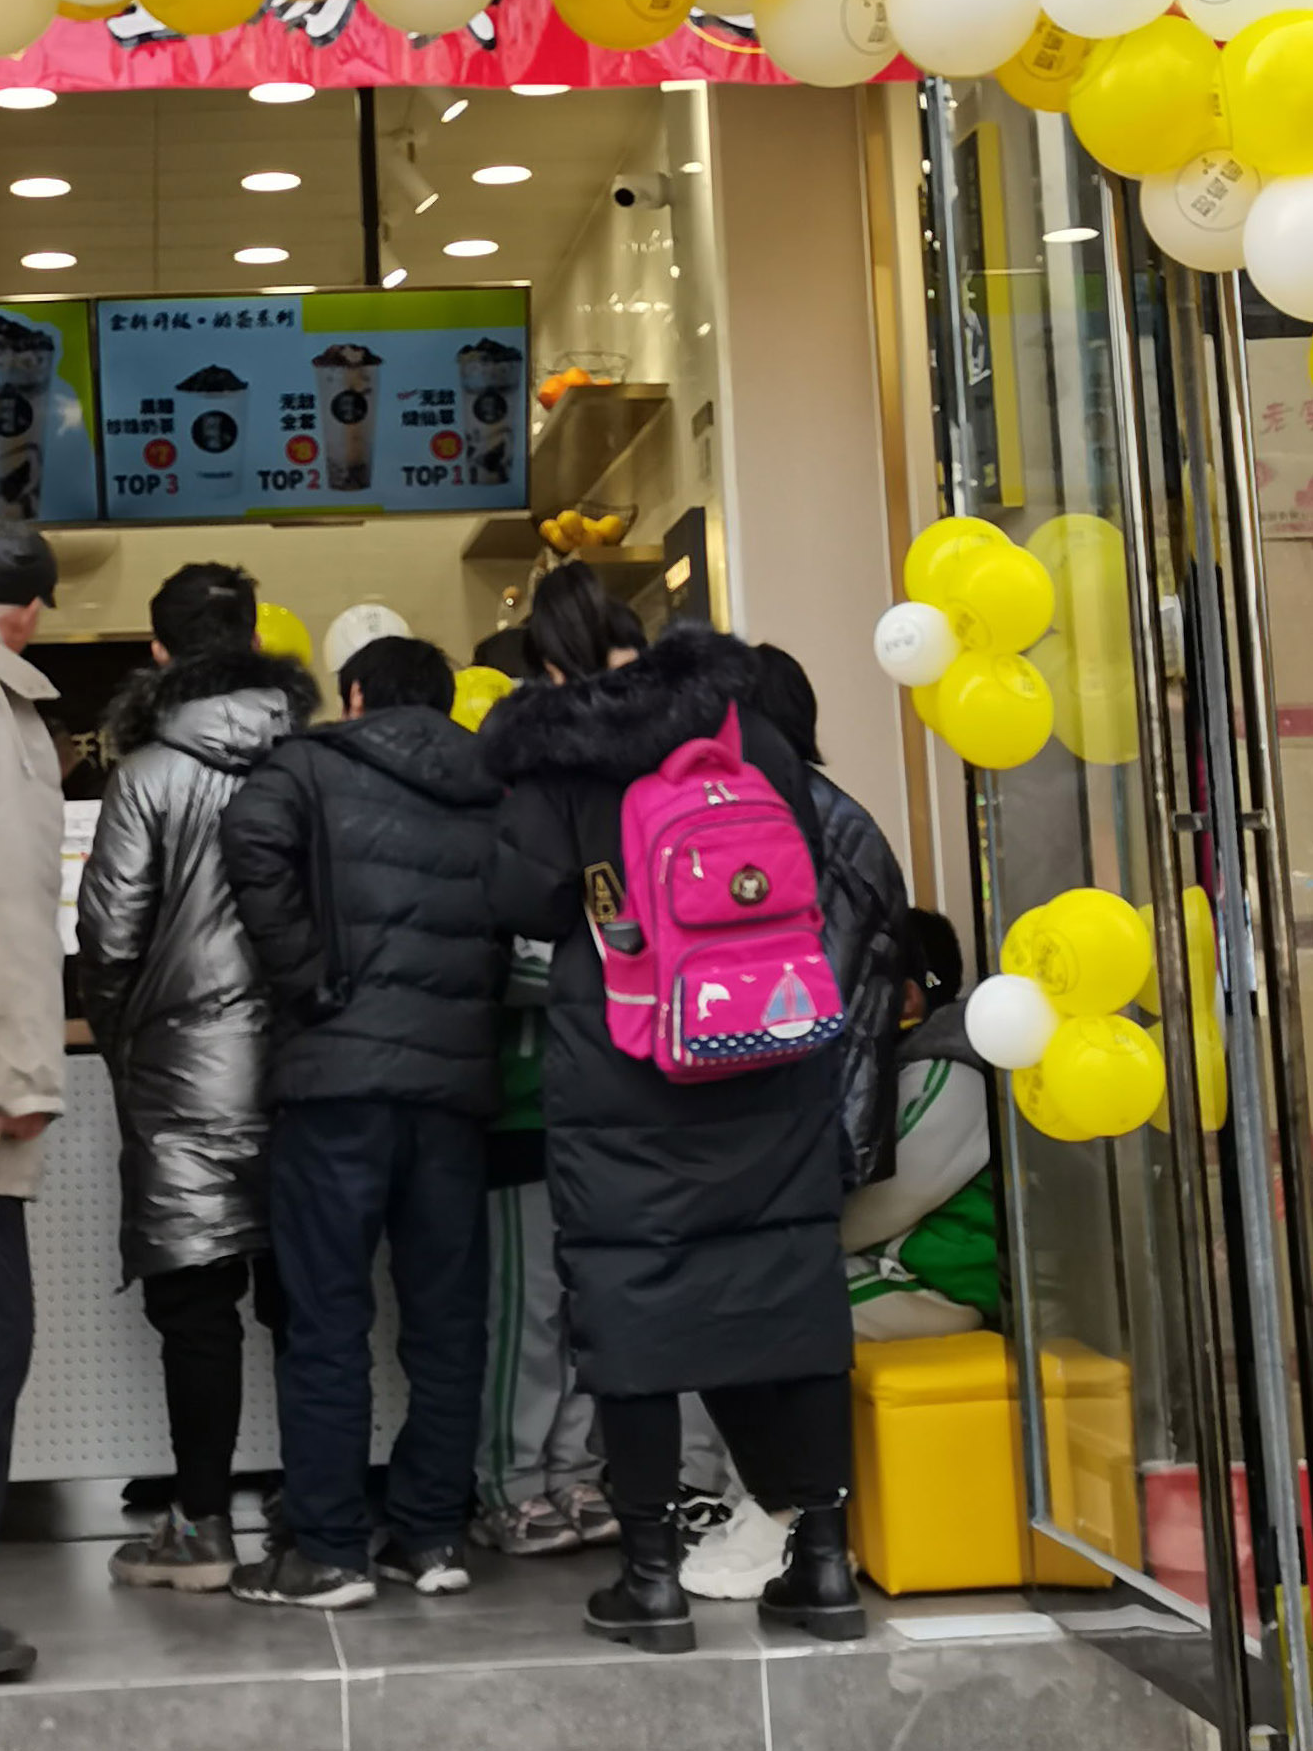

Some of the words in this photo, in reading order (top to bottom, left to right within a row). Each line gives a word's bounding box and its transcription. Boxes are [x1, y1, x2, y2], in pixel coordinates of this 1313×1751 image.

[113, 472, 162, 496] TOP
[165, 472, 180, 495] 3
[257, 467, 304, 492] TOP
[306, 467, 321, 490] 2
[401, 465, 449, 487] TOP
